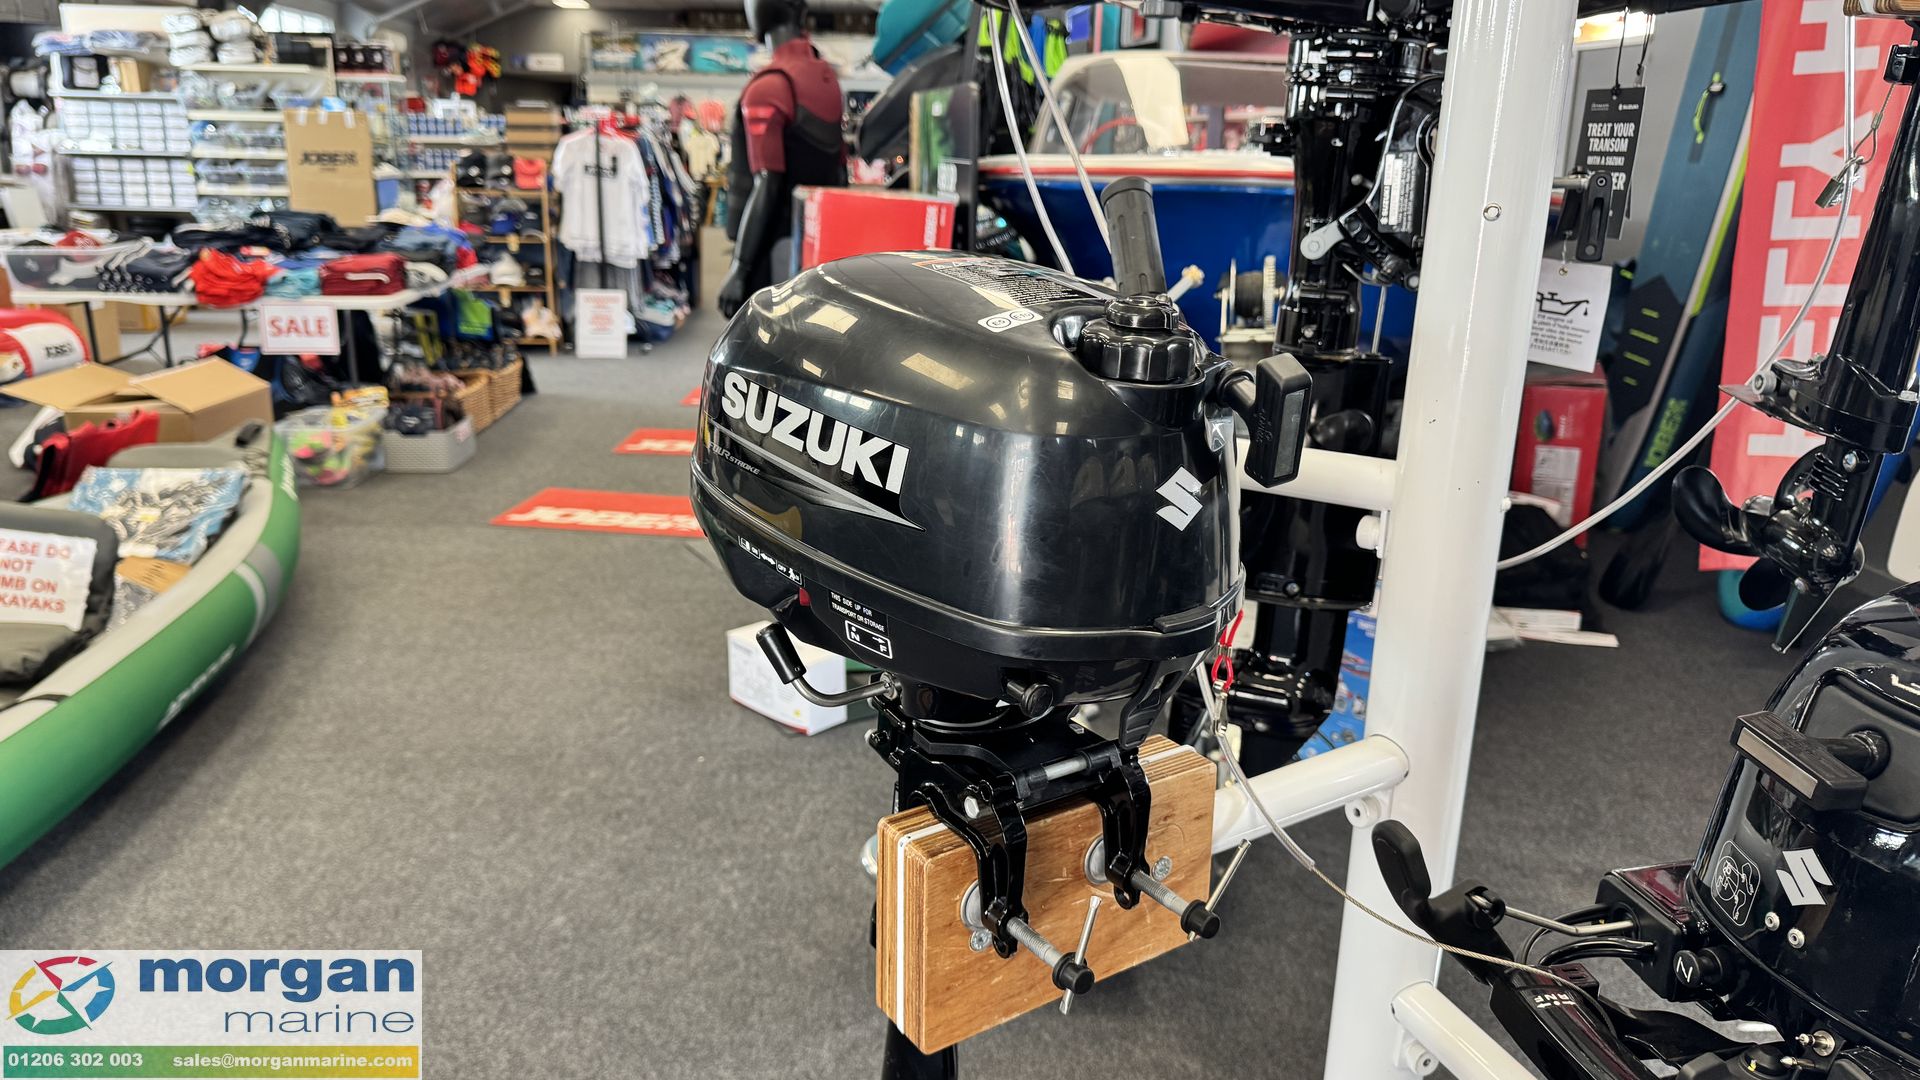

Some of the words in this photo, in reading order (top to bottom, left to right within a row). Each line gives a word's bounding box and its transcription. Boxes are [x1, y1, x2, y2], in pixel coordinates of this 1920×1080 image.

[1587, 122, 1613, 137] TREAT
[1613, 122, 1636, 137] YOUR
[1588, 138, 1630, 153] TRANSOM
[267, 315, 331, 337] SALE
[721, 371, 910, 495] SUZUKI
[708, 441, 731, 460] FOUR
[729, 456, 761, 475] STROKE
[47, 543, 71, 560] DO
[0, 559, 34, 573] NOT
[32, 578, 58, 594] ON
[831, 591, 841, 602] THIS
[842, 597, 853, 608] SIDE
[854, 603, 862, 611] UP
[862, 607, 873, 617] FOR
[831, 601, 857, 619] TRANSPORT
[856, 614, 865, 622] OR
[863, 617, 885, 632] STORAGE
[850, 631, 861, 642] N
[879, 644, 888, 653] F
